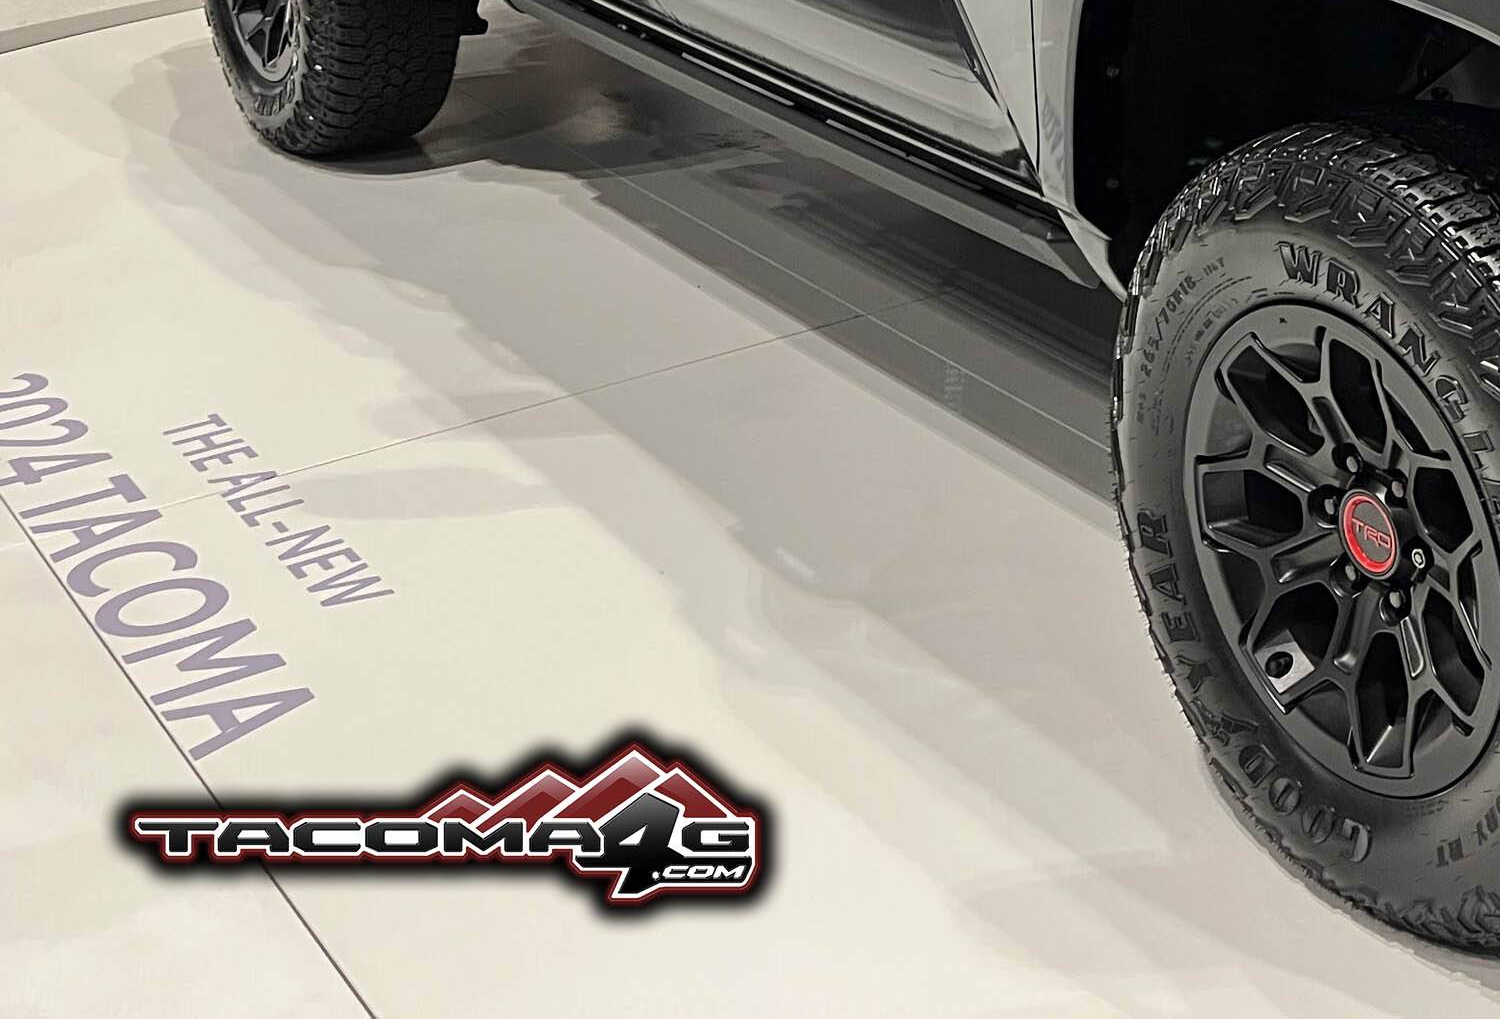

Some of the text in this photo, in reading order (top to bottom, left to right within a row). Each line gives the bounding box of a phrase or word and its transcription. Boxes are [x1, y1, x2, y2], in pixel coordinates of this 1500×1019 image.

[19, 473, 316, 761] TACOMA
[162, 413, 395, 608] THE ALL-NEW
[1136, 508, 1373, 862] GOODYEAR
